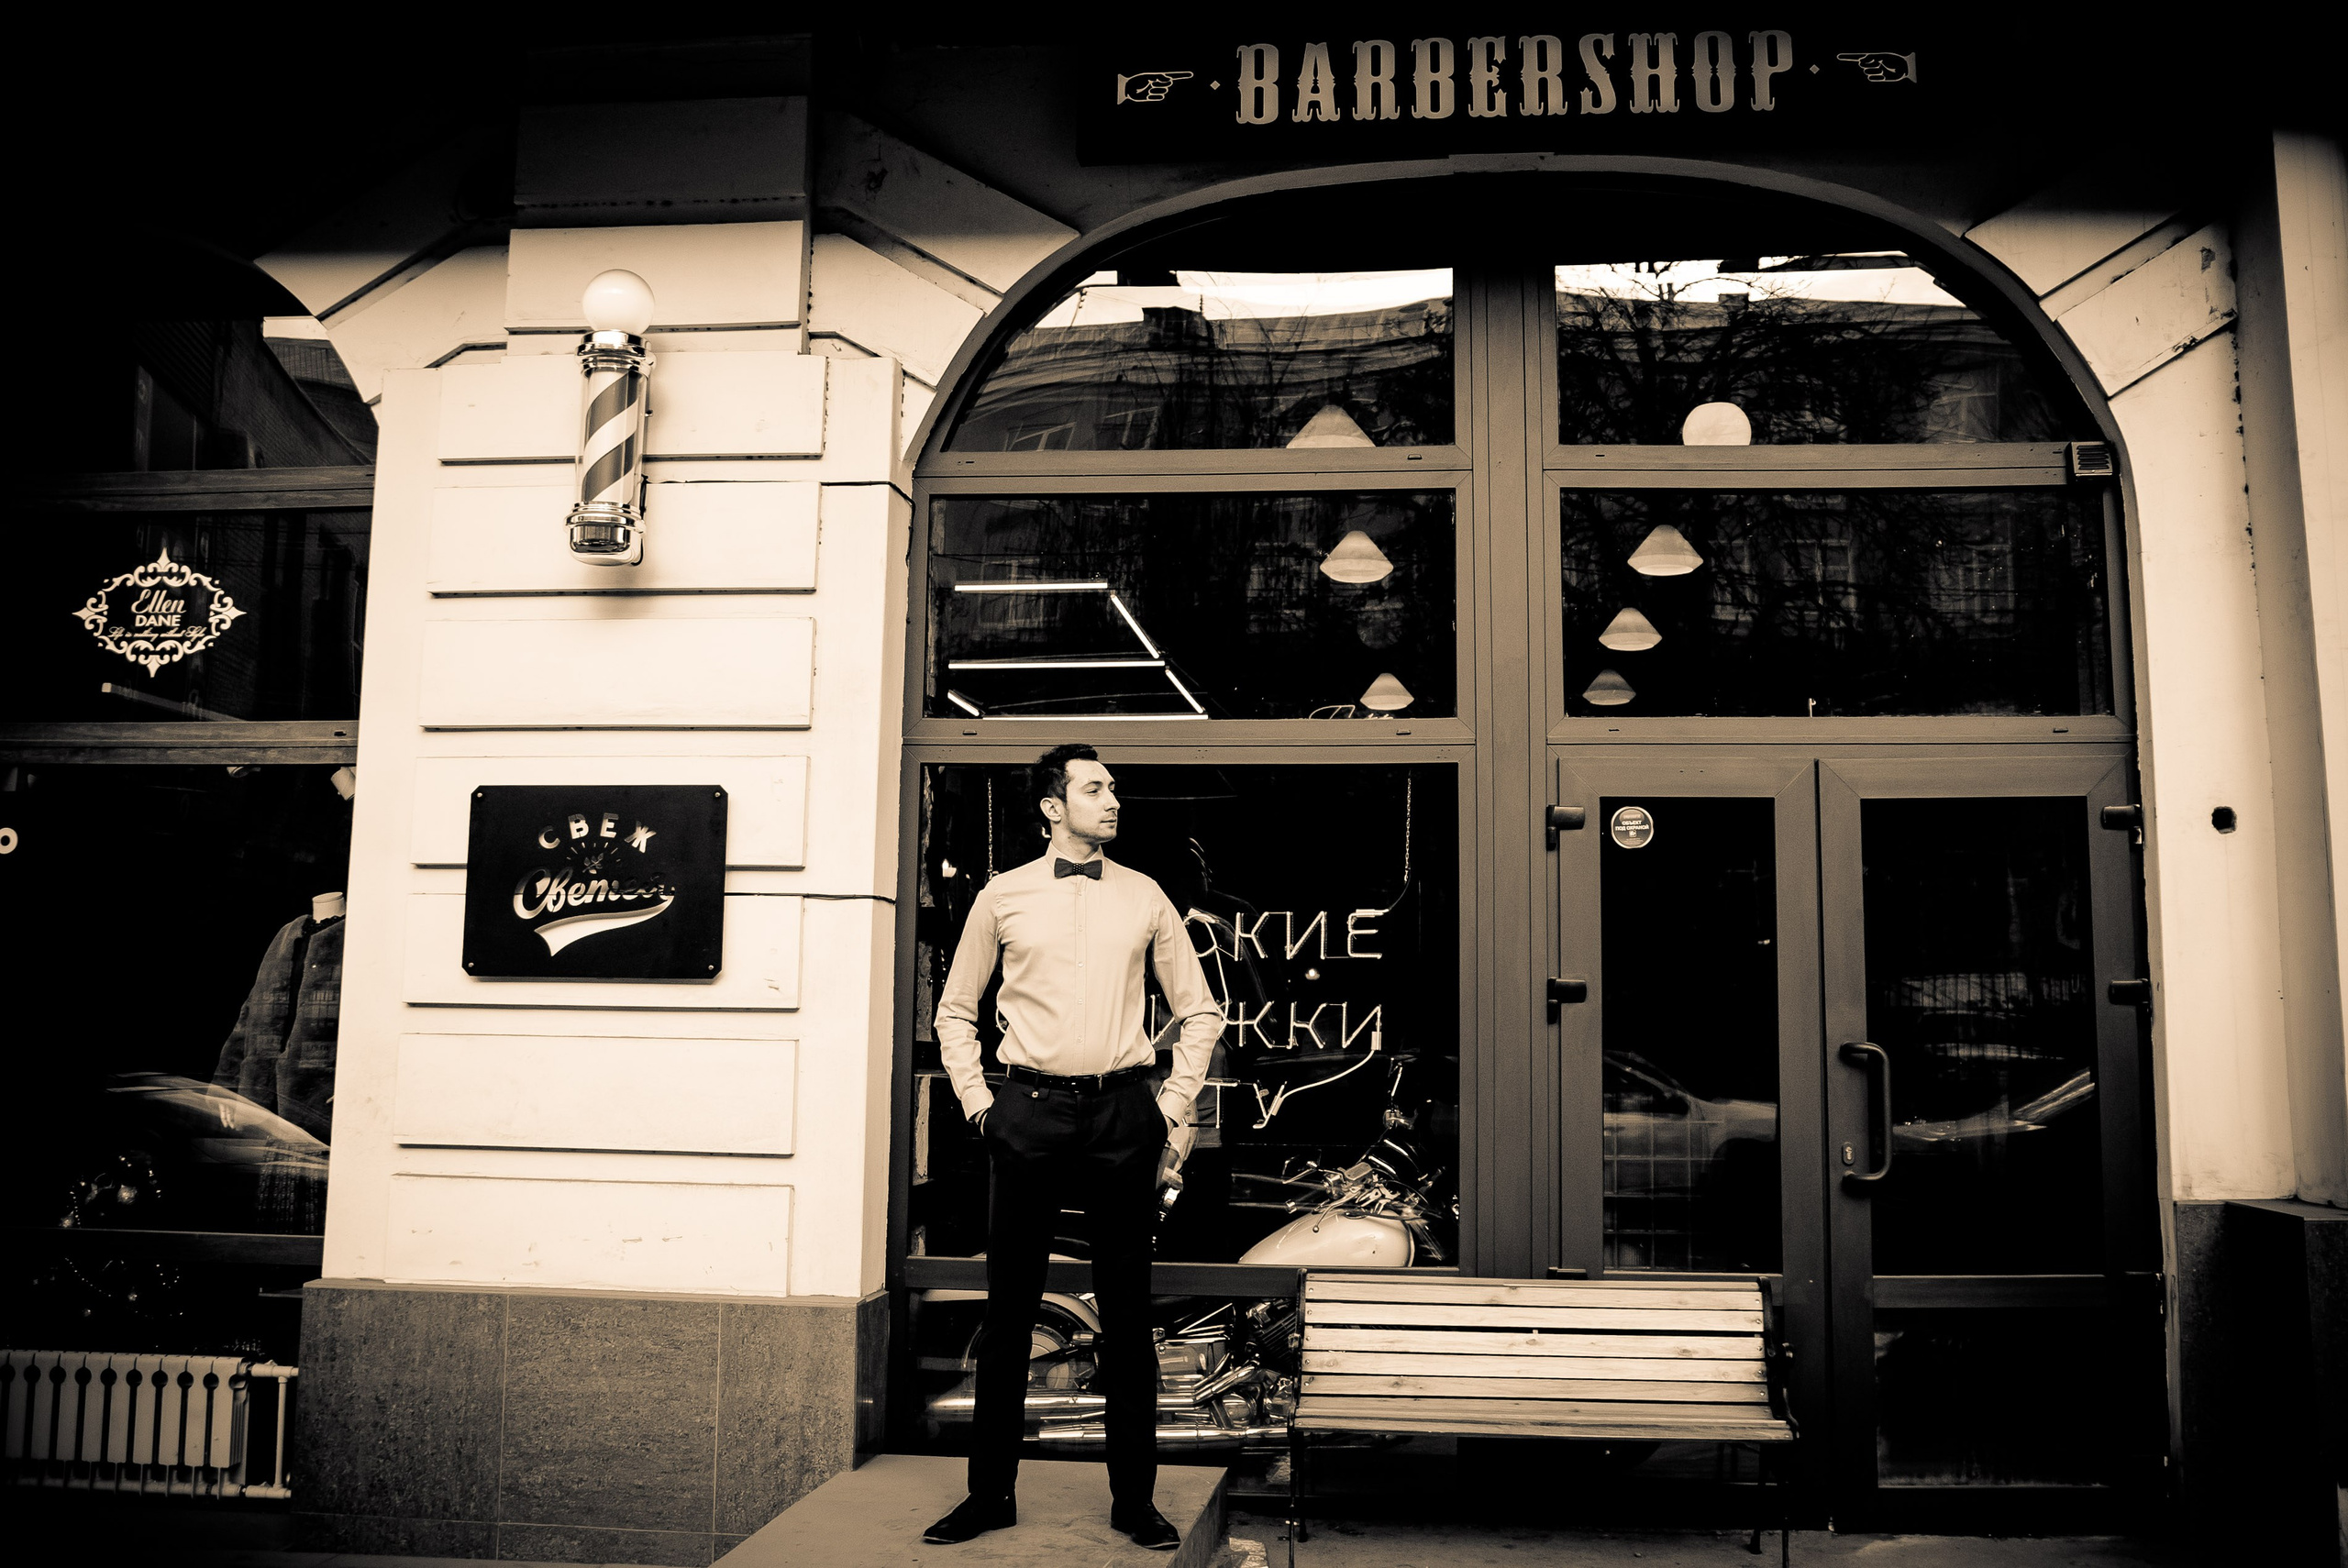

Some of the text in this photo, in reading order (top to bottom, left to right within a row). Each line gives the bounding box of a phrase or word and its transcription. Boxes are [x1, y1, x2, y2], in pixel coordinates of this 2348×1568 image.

[1235, 29, 1793, 125] BARBERSHOP
[131, 589, 187, 613] Ellen
[135, 614, 182, 627] DANE
[537, 812, 657, 854] СВЕЖ
